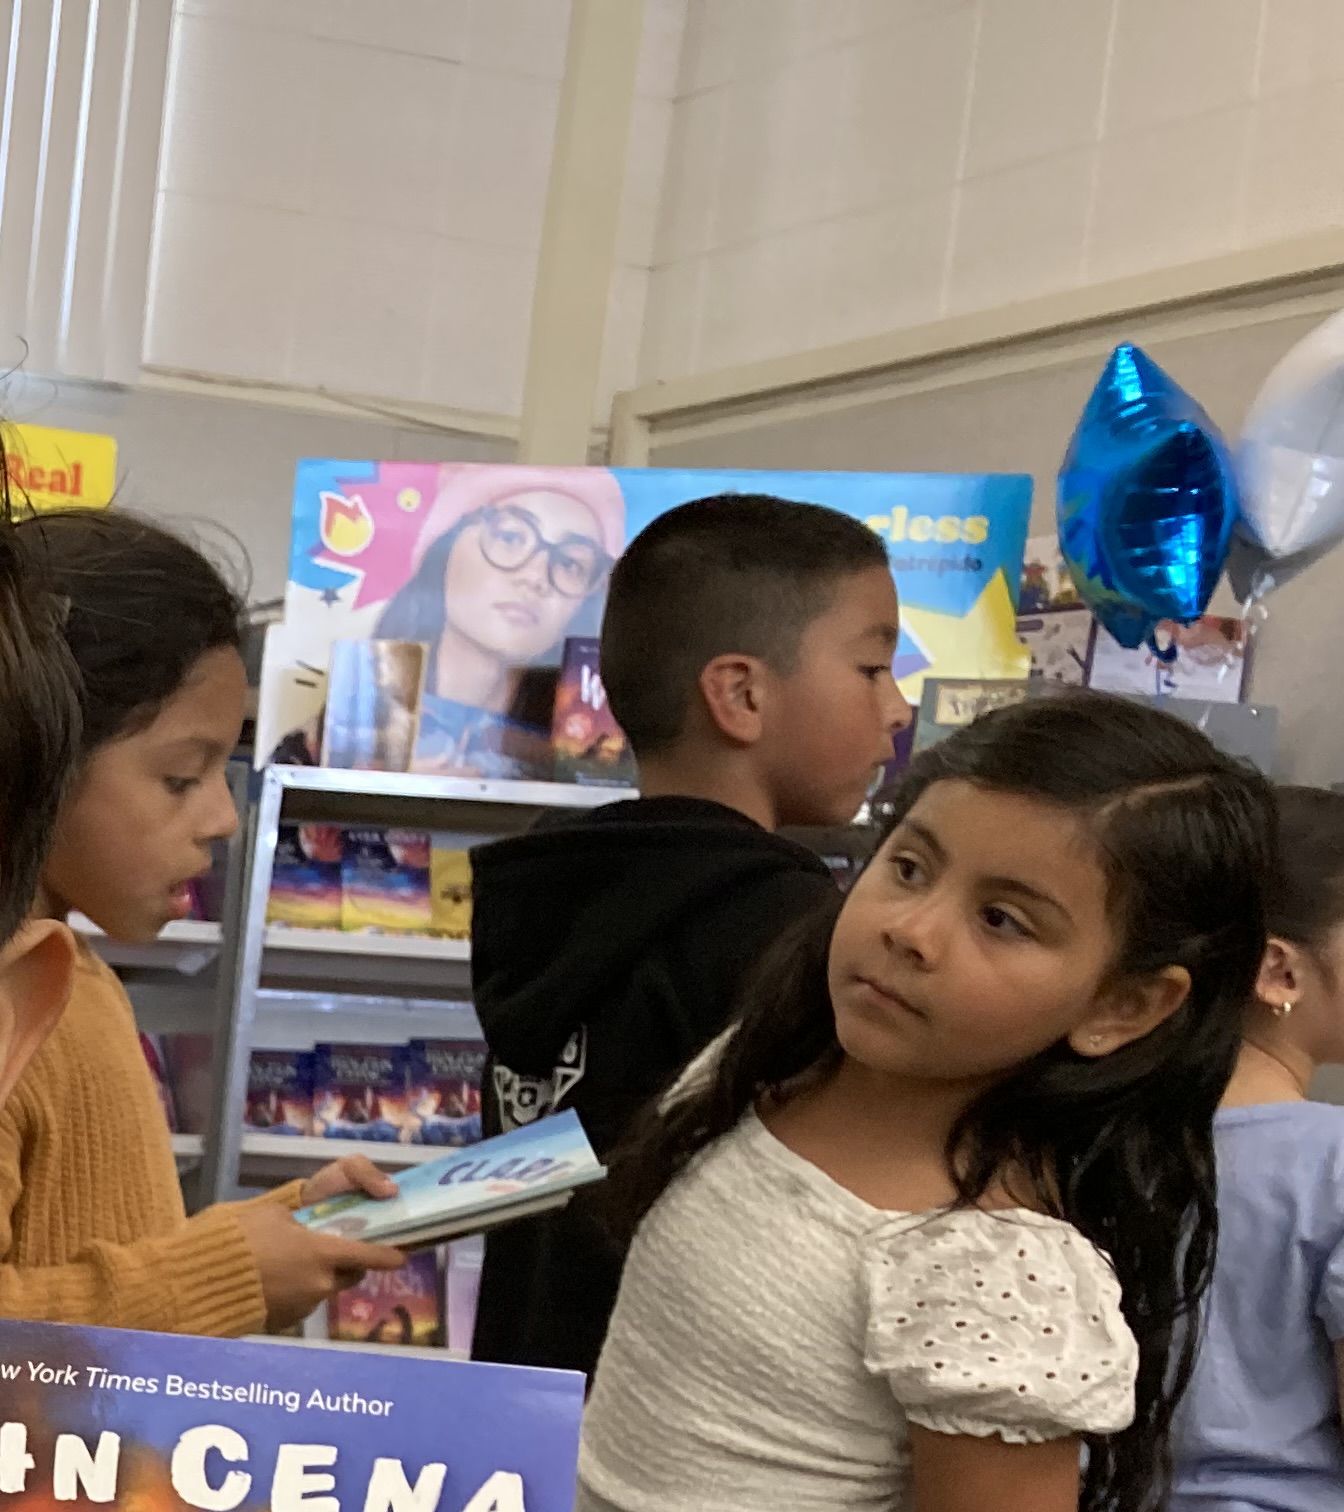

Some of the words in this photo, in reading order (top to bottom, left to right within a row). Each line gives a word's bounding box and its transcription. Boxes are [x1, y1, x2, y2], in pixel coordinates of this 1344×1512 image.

[25, 1359, 79, 1389] York
[84, 1365, 160, 1396] Times
[164, 1373, 302, 1412] Bestselling
[306, 1387, 395, 1418] Author
